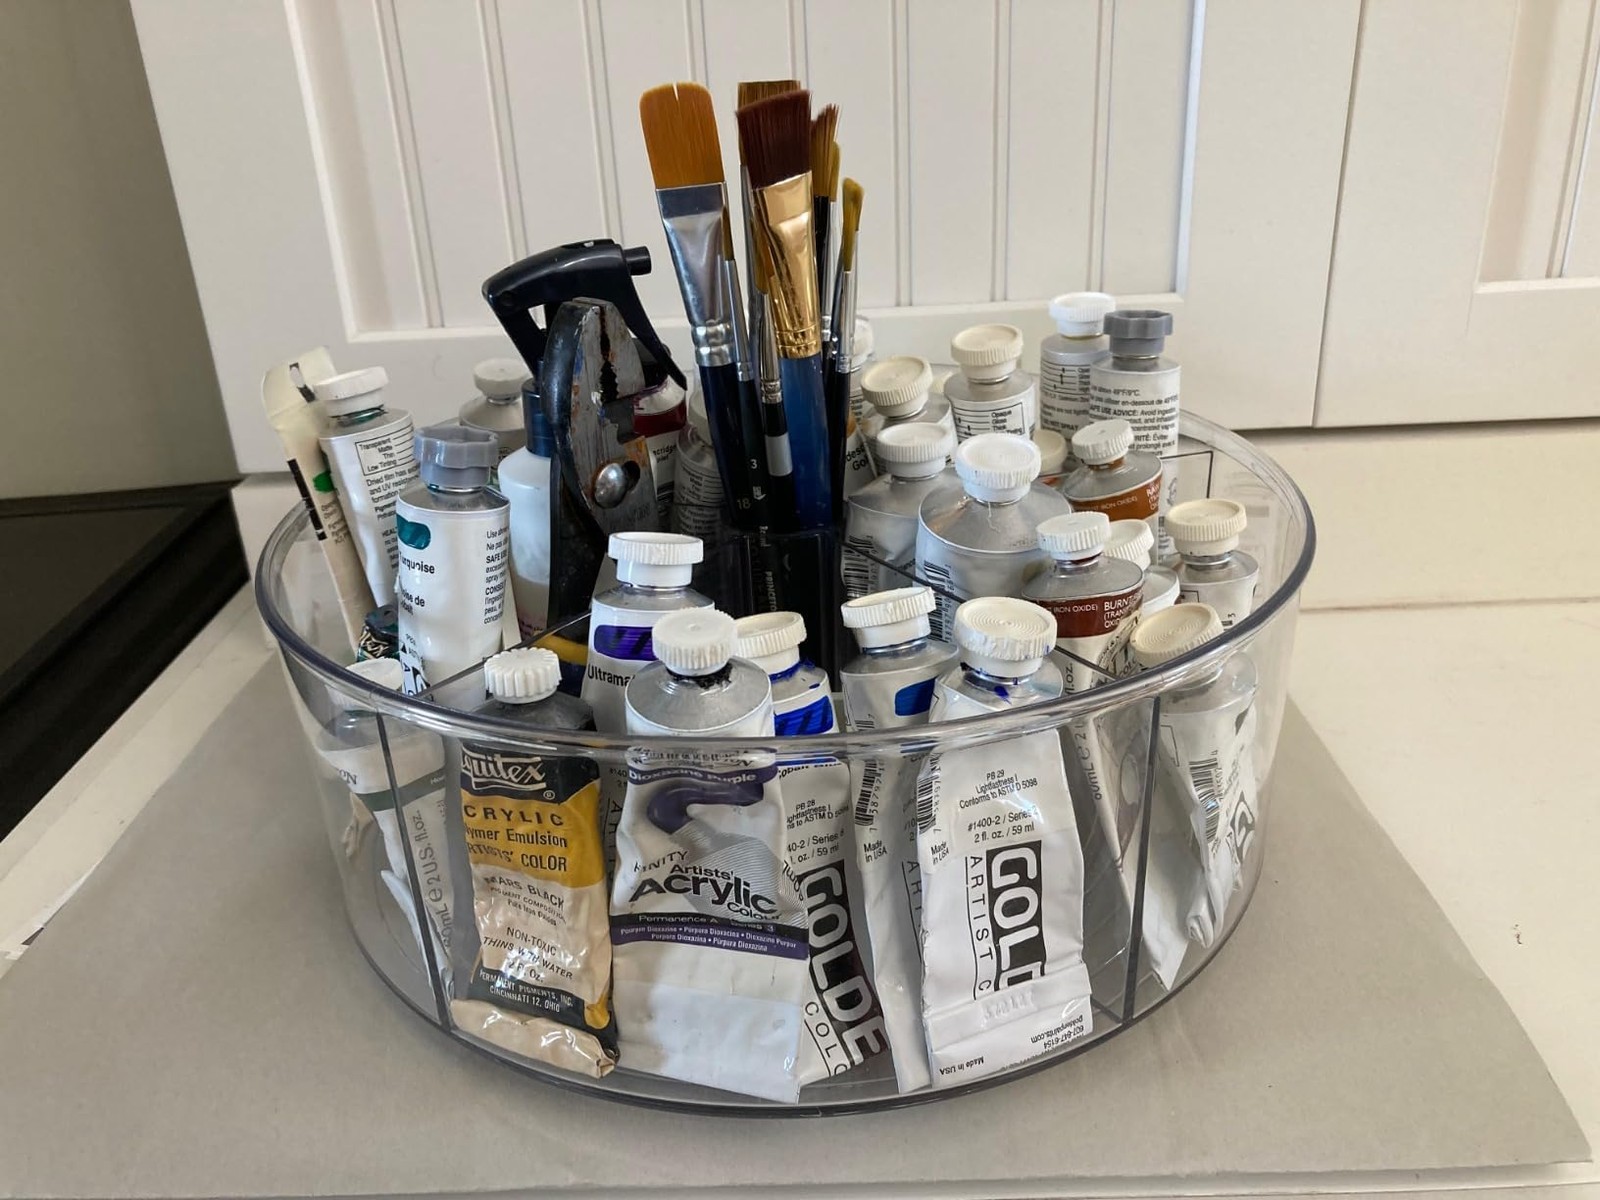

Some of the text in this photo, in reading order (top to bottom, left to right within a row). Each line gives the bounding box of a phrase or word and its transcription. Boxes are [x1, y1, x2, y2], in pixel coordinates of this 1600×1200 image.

[750, 459, 758, 469] 3
[486, 530, 497, 539] Use
[486, 543, 495, 551] Ne
[486, 554, 500, 564] SAFE
[1072, 603, 1099, 613] OXIDE)
[986, 769, 1005, 781] PB 29
[959, 794, 991, 809] Conforms
[990, 791, 998, 799] to
[1016, 782, 1022, 791] D
[795, 801, 806, 813] PB
[796, 818, 804, 827] to
[804, 812, 826, 824] ASTM
[827, 811, 834, 820] D
[968, 815, 1001, 832] #1400-2
[507, 828, 568, 848] Emulsion
[812, 833, 839, 845] Series
[974, 833, 980, 844] 2
[991, 830, 1005, 839] oz.
[1012, 824, 1023, 836] 59
[1024, 821, 1035, 833] ml
[521, 853, 567, 872] COLOR
[797, 853, 810, 863] oz.
[817, 846, 829, 857] 59
[865, 854, 873, 863] in
[670, 864, 734, 880] Artists'
[527, 884, 565, 909] BLACK
[629, 874, 778, 915] Acrylic
[970, 855, 994, 961] ARTIST
[639, 915, 707, 923] Permanence
[506, 926, 557, 957] NON-TOXIC
[483, 936, 515, 951] THINS
[542, 958, 573, 980] WATER
[529, 968, 544, 983] Oz.
[544, 1000, 560, 1013] OHIO
[939, 1056, 984, 1076] Made in USA
